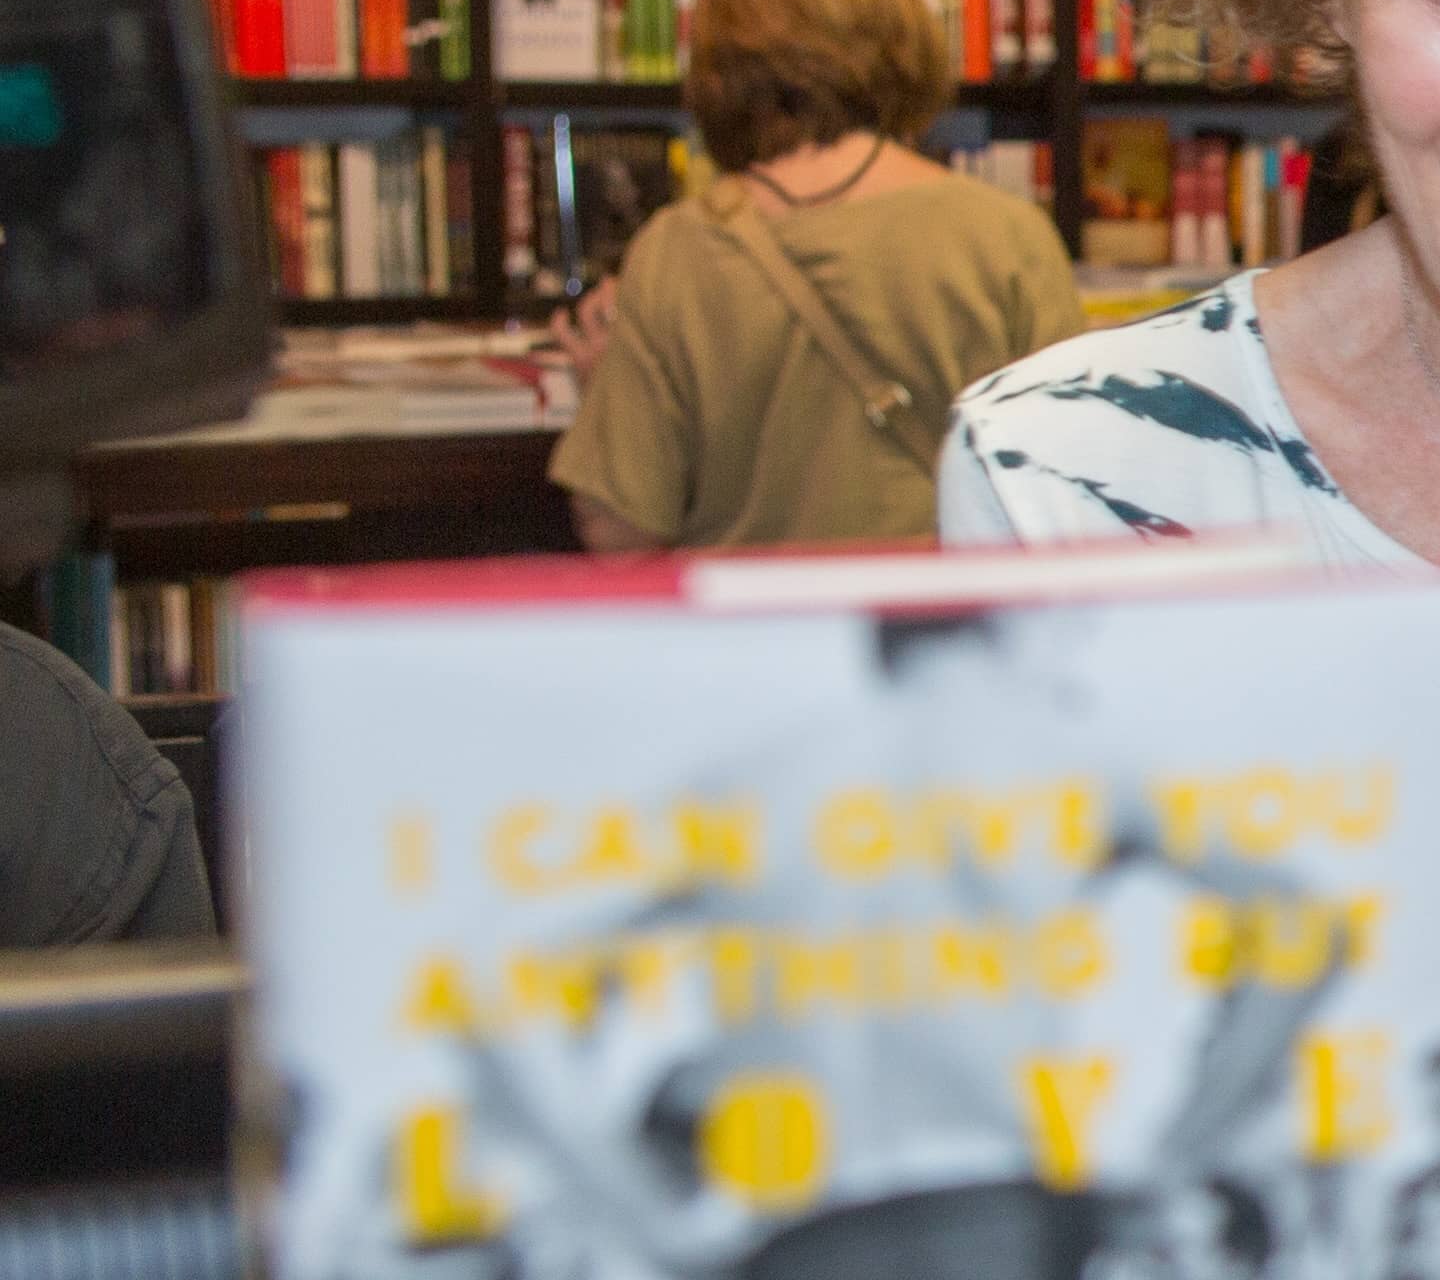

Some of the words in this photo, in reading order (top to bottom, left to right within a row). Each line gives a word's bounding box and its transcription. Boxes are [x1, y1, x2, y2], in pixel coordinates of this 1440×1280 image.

[488, 788, 758, 893] CAN
[814, 776, 1102, 880] GIVE
[1153, 763, 1396, 862] YOU
[400, 913, 1108, 1036] ANYTHING
[1179, 892, 1380, 992] BUT
